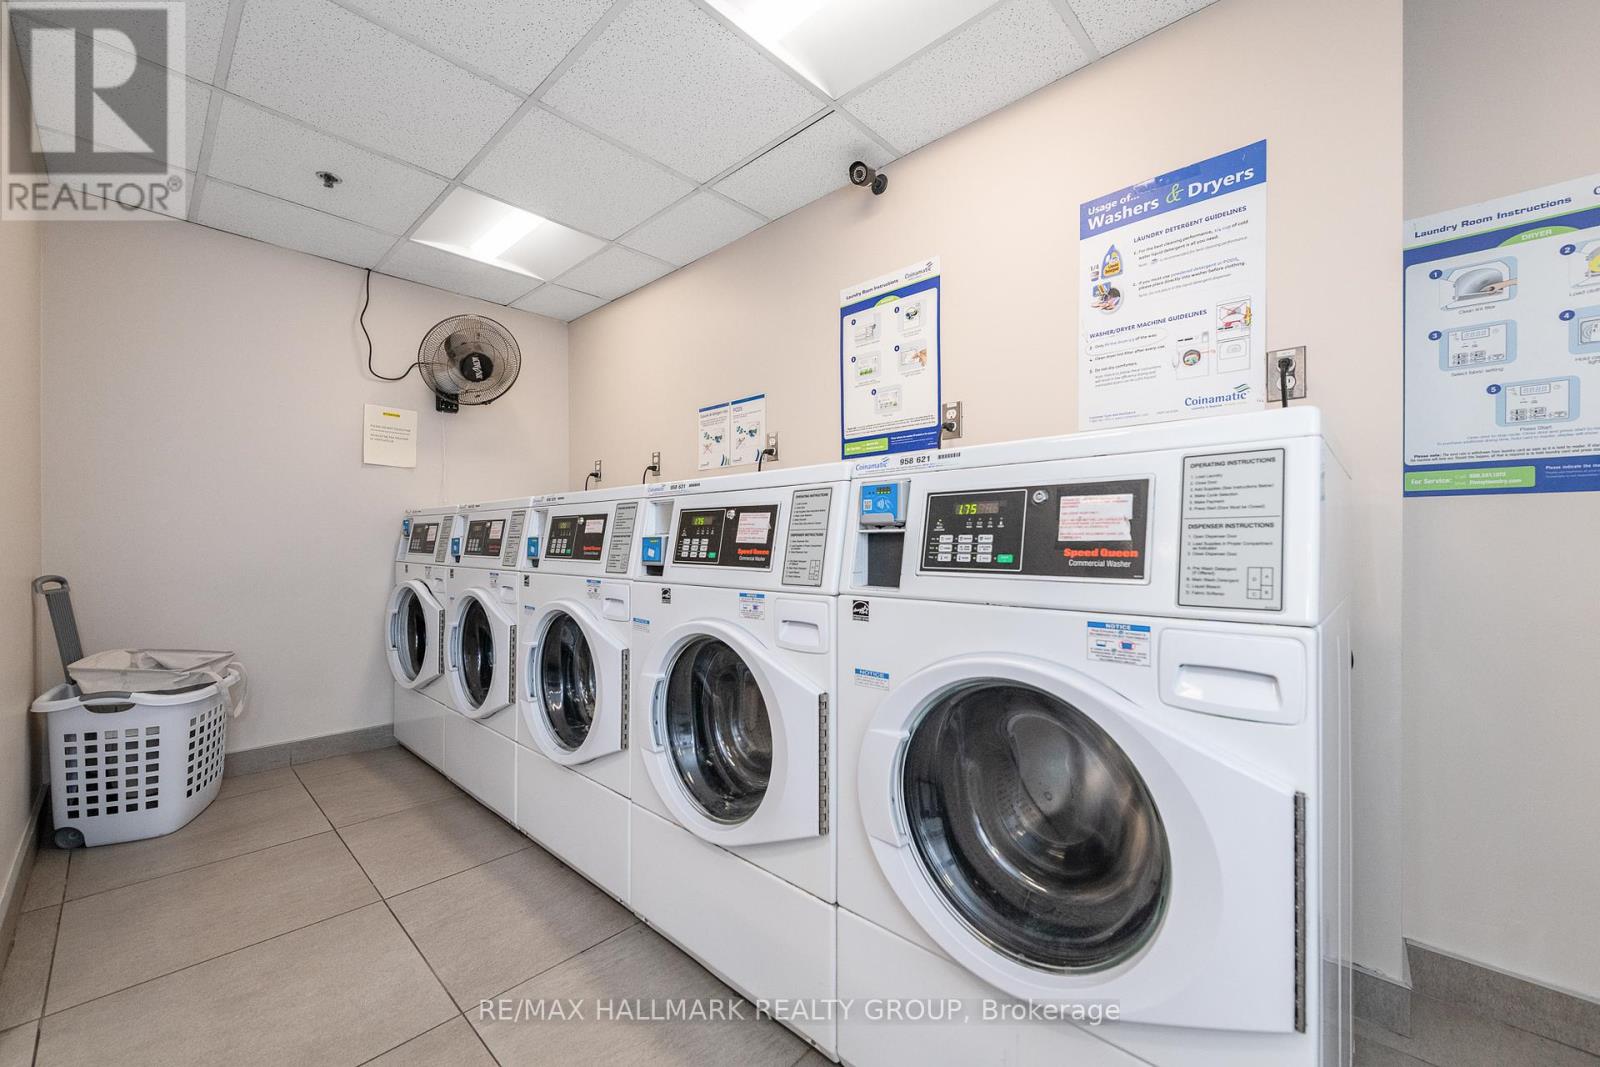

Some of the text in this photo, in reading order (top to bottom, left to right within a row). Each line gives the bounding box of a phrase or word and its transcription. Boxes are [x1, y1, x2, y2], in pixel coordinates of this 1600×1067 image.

[1088, 168, 1254, 230] Washers & Dryers
[1088, 200, 1117, 215] Usage
[1415, 196, 1572, 238] Laundry Room Instructions
[1133, 205, 1247, 243] LAUNDRY DETERGENT GUIDELINES
[1521, 230, 1552, 241] DRYER
[1090, 309, 1207, 339] WASHER/DRYER MACHINE GUIDELINES
[1184, 391, 1247, 407] Coinamatic
[899, 457, 914, 466] 958
[916, 455, 931, 464] 621
[1190, 457, 1276, 469] OPERATING INSTRUCTIONS
[1063, 548, 1139, 559] Speed Queen
[1068, 559, 1132, 568] Commercial Washer
[1105, 623, 1130, 631] NOTICE
